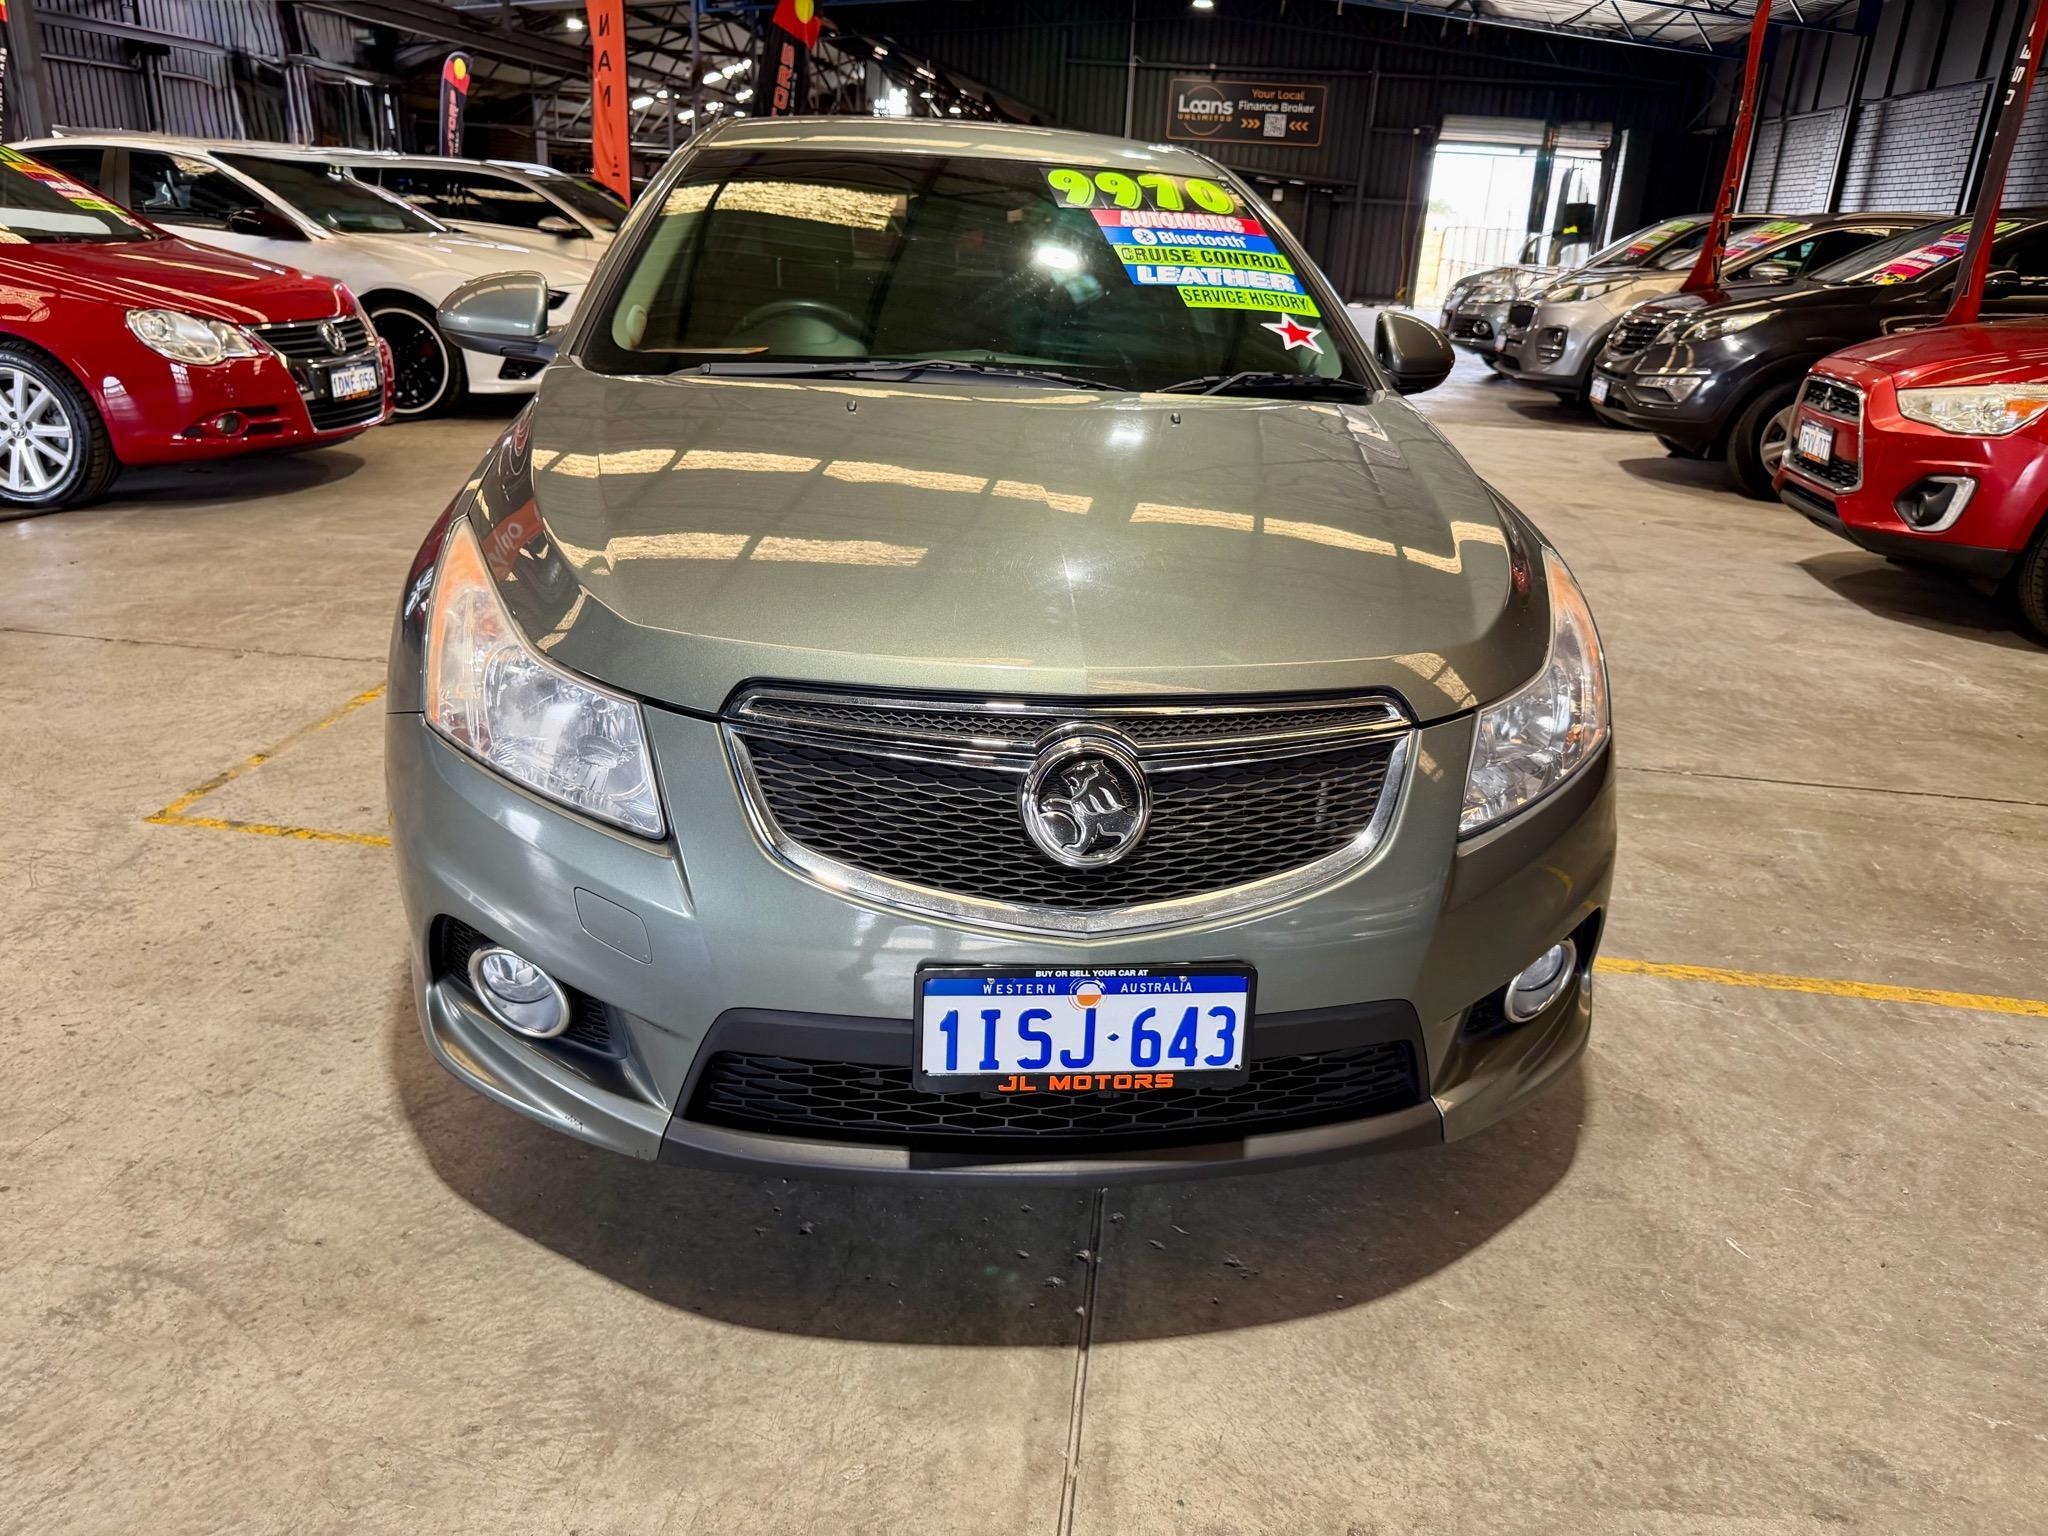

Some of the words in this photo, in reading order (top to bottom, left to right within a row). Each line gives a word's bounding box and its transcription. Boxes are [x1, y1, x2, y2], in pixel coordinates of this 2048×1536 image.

[1252, 89, 1276, 99] Your
[1278, 90, 1305, 100] Local
[1178, 94, 1234, 115] Loans
[1238, 100, 1279, 112] Finance
[1281, 102, 1315, 113] Broker
[1177, 114, 1233, 122] UNLIMITED
[1047, 169, 1236, 214] 9970
[1120, 210, 1245, 233] AUTOMATIC
[1122, 247, 1193, 263] CRUISE
[1200, 249, 1287, 271] CONTROL
[1137, 266, 1297, 292] LEATHER
[1183, 288, 1245, 304] SERVICE
[1250, 292, 1307, 311] HISTORY
[1092, 969, 1117, 977] YOUR
[983, 984, 1056, 994] WESTERN
[1121, 982, 1192, 993] AUSTRALIA
[998, 1076, 1036, 1091] JL
[1049, 1073, 1174, 1091] MOTORS
